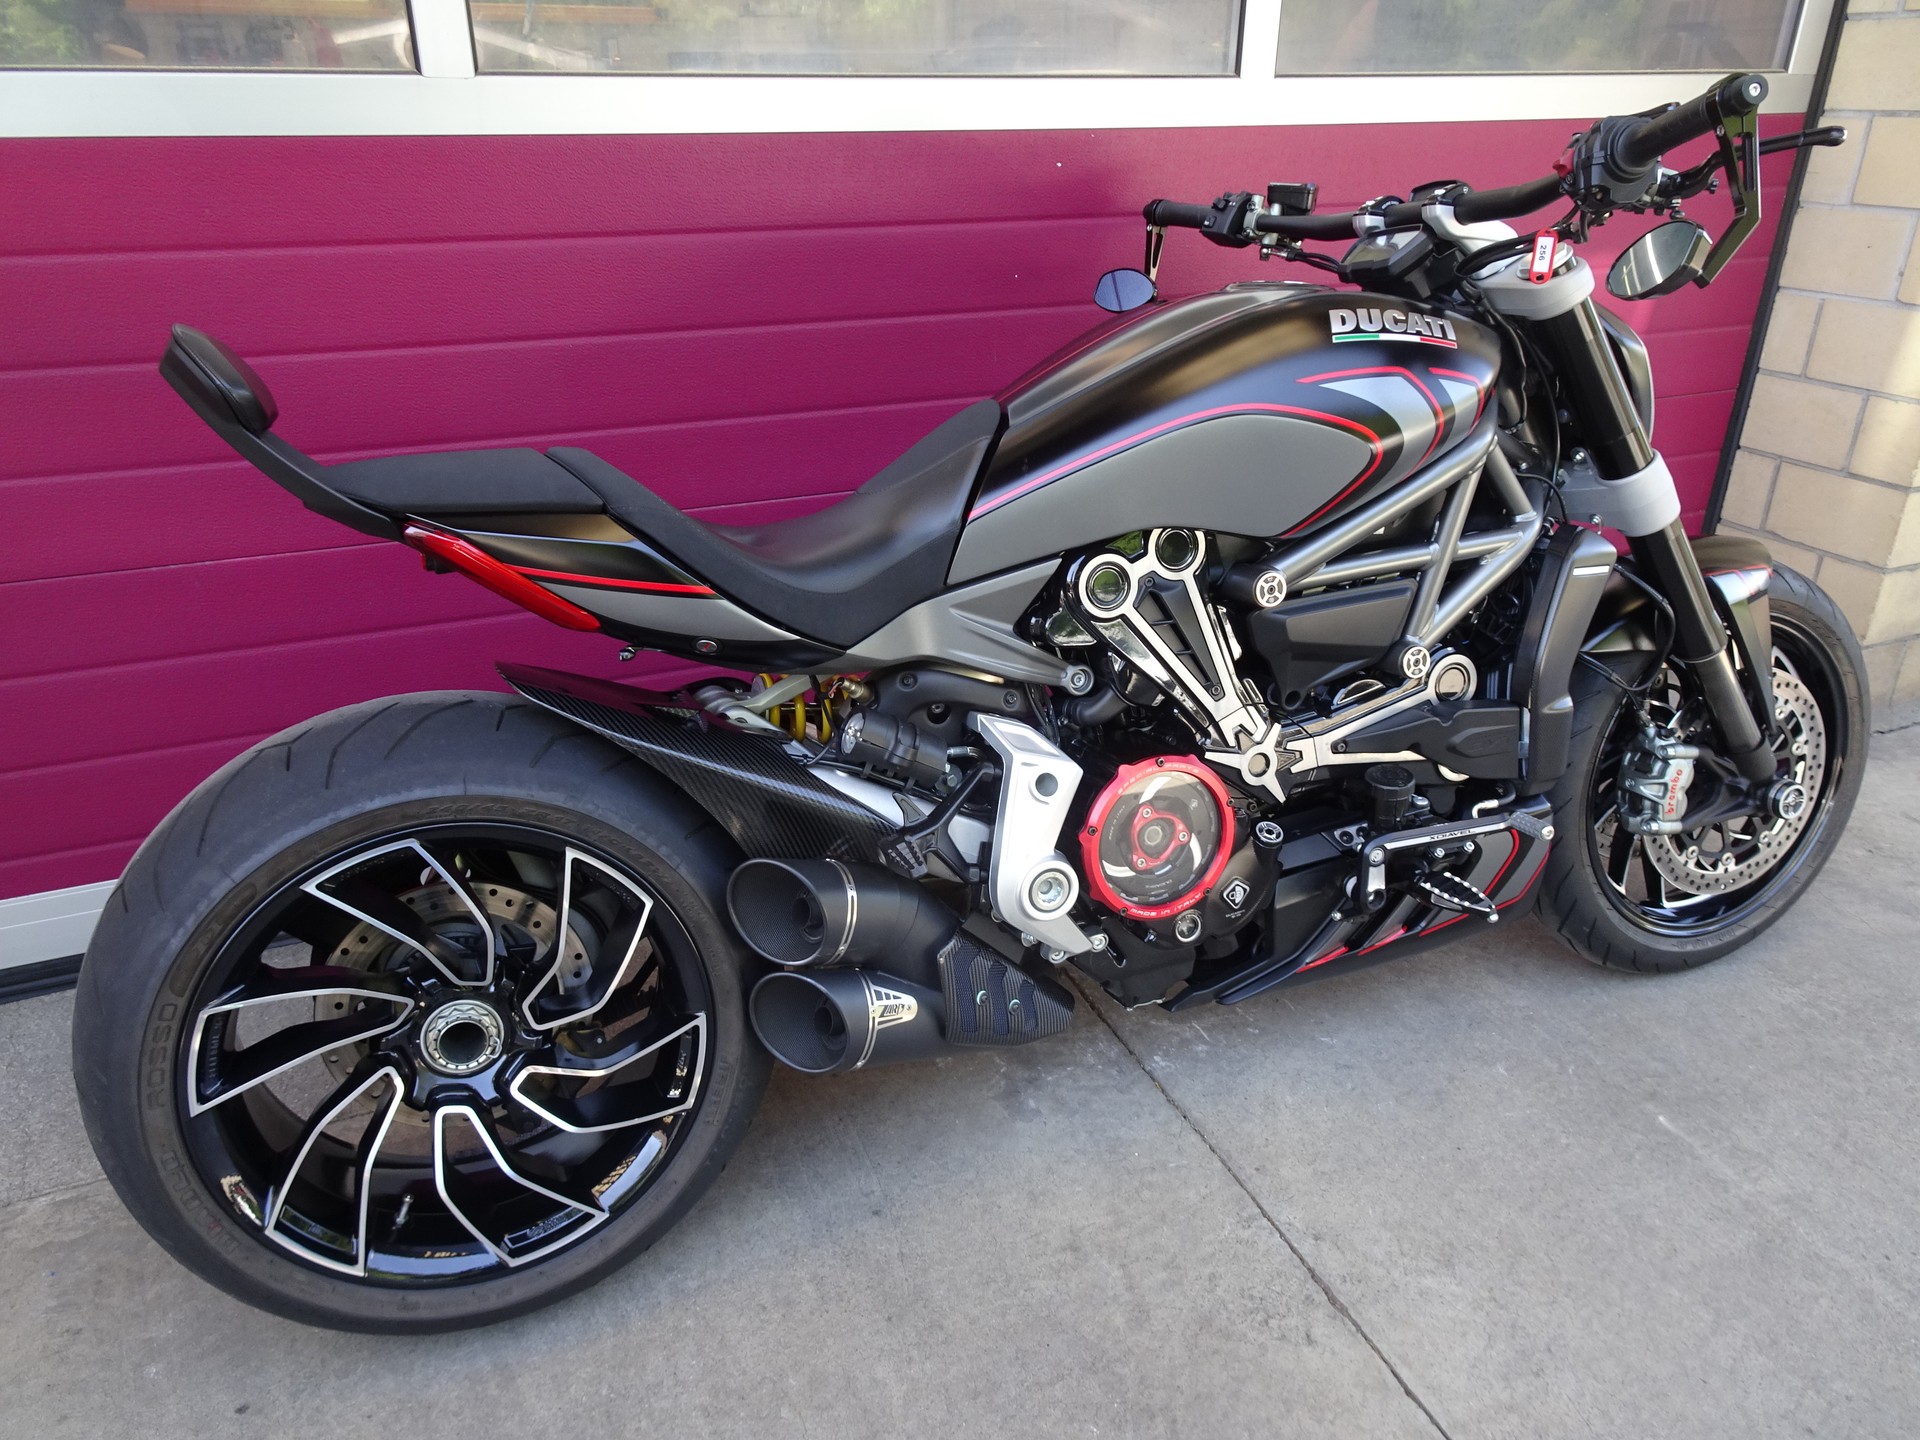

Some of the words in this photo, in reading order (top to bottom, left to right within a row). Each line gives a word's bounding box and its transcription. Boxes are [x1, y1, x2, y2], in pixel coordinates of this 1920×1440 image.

[1538, 244, 1548, 261] 256
[1328, 308, 1457, 340] DUCATI
[1117, 766, 1161, 795] SPECIAL
[1163, 763, 1200, 775] PARTS
[1665, 768, 1683, 815] brembo
[1429, 829, 1475, 841] XDIAVEL
[1130, 908, 1158, 917] MADE
[1174, 892, 1202, 912] ITALY
[146, 1002, 177, 1109] ROSSO
[160, 1150, 242, 1254] DIABLO
